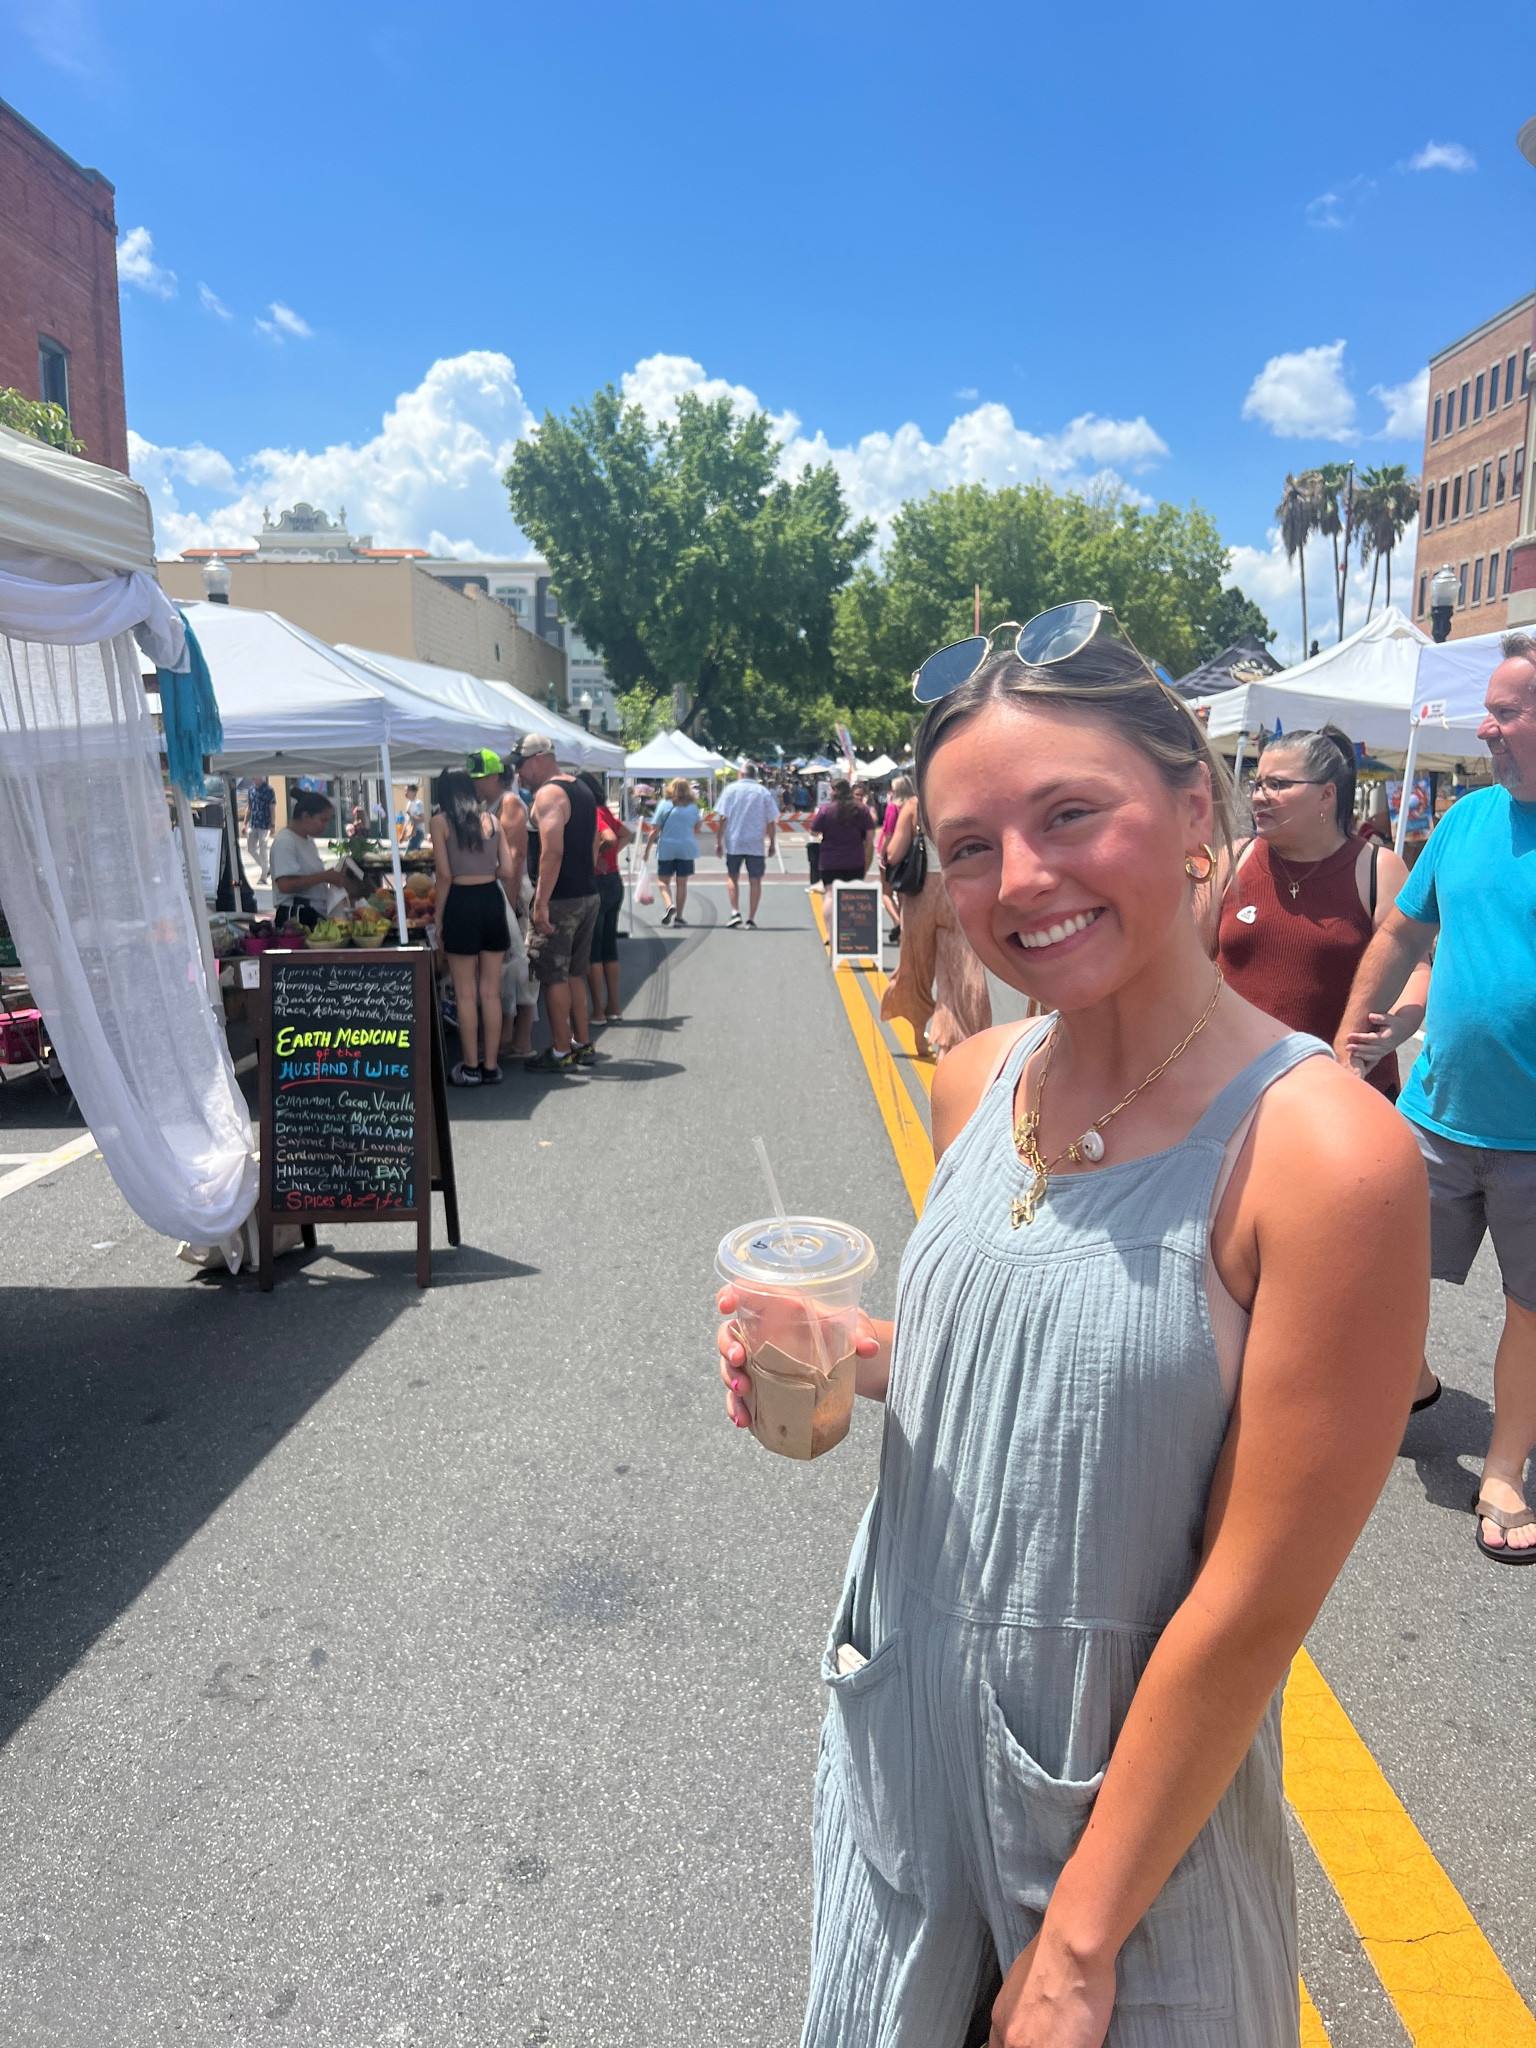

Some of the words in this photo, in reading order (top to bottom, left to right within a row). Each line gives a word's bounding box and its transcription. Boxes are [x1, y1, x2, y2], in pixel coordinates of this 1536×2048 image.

[278, 966, 323, 981] Apricot
[274, 980, 326, 997] Moringa,
[327, 980, 380, 995] Soursop,
[274, 994, 340, 1007] Dandelion,
[274, 1005, 311, 1018] Maca,
[276, 1026, 332, 1057] EARTH
[332, 1027, 411, 1049] MEDICINE
[315, 1048, 330, 1061] of
[337, 1048, 362, 1058] the
[279, 1060, 348, 1080] HUSBAND
[365, 1060, 409, 1078] WIFE
[373, 1090, 416, 1113] Vanilla,
[350, 1110, 389, 1127] Myrrh,
[275, 1122, 320, 1136] Dragon's
[361, 1138, 415, 1156] Lavender,
[276, 1149, 346, 1164] Cardamom,
[276, 1164, 330, 1179] Hibiscus,
[373, 1165, 412, 1180] BAY
